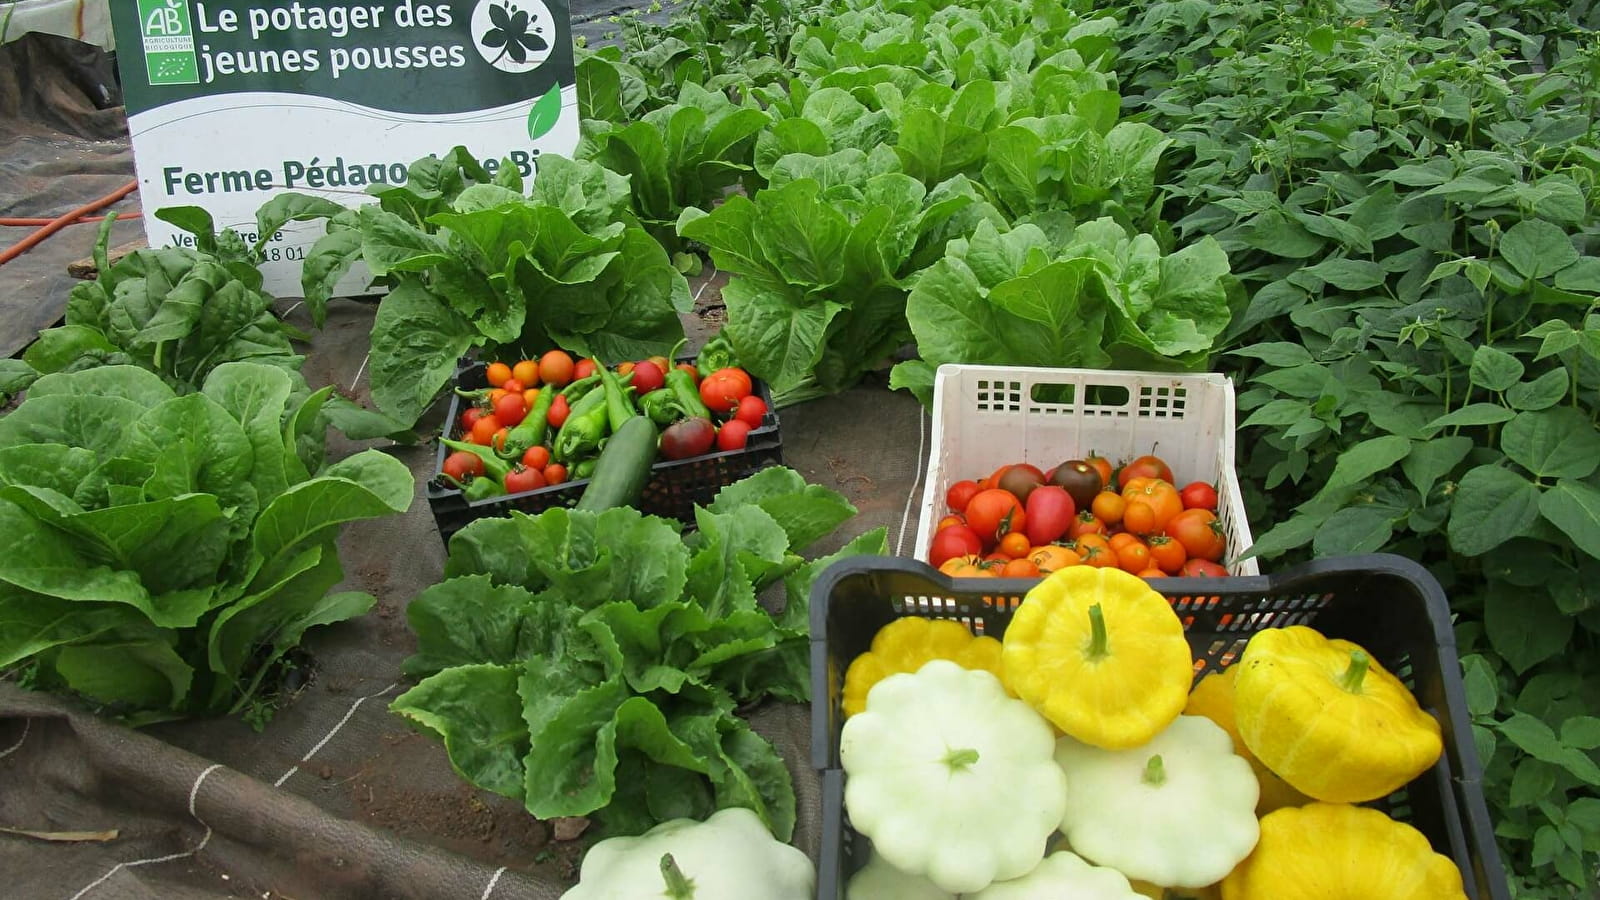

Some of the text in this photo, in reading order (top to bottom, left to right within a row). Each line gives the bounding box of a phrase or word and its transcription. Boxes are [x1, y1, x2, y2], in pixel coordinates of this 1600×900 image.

[146, 8, 183, 35] AB
[196, 0, 453, 39] Le potager des
[202, 44, 466, 83] jeunes pousses
[163, 149, 540, 195] Ferme Pédagoe Bi
[285, 246, 305, 261] 01
